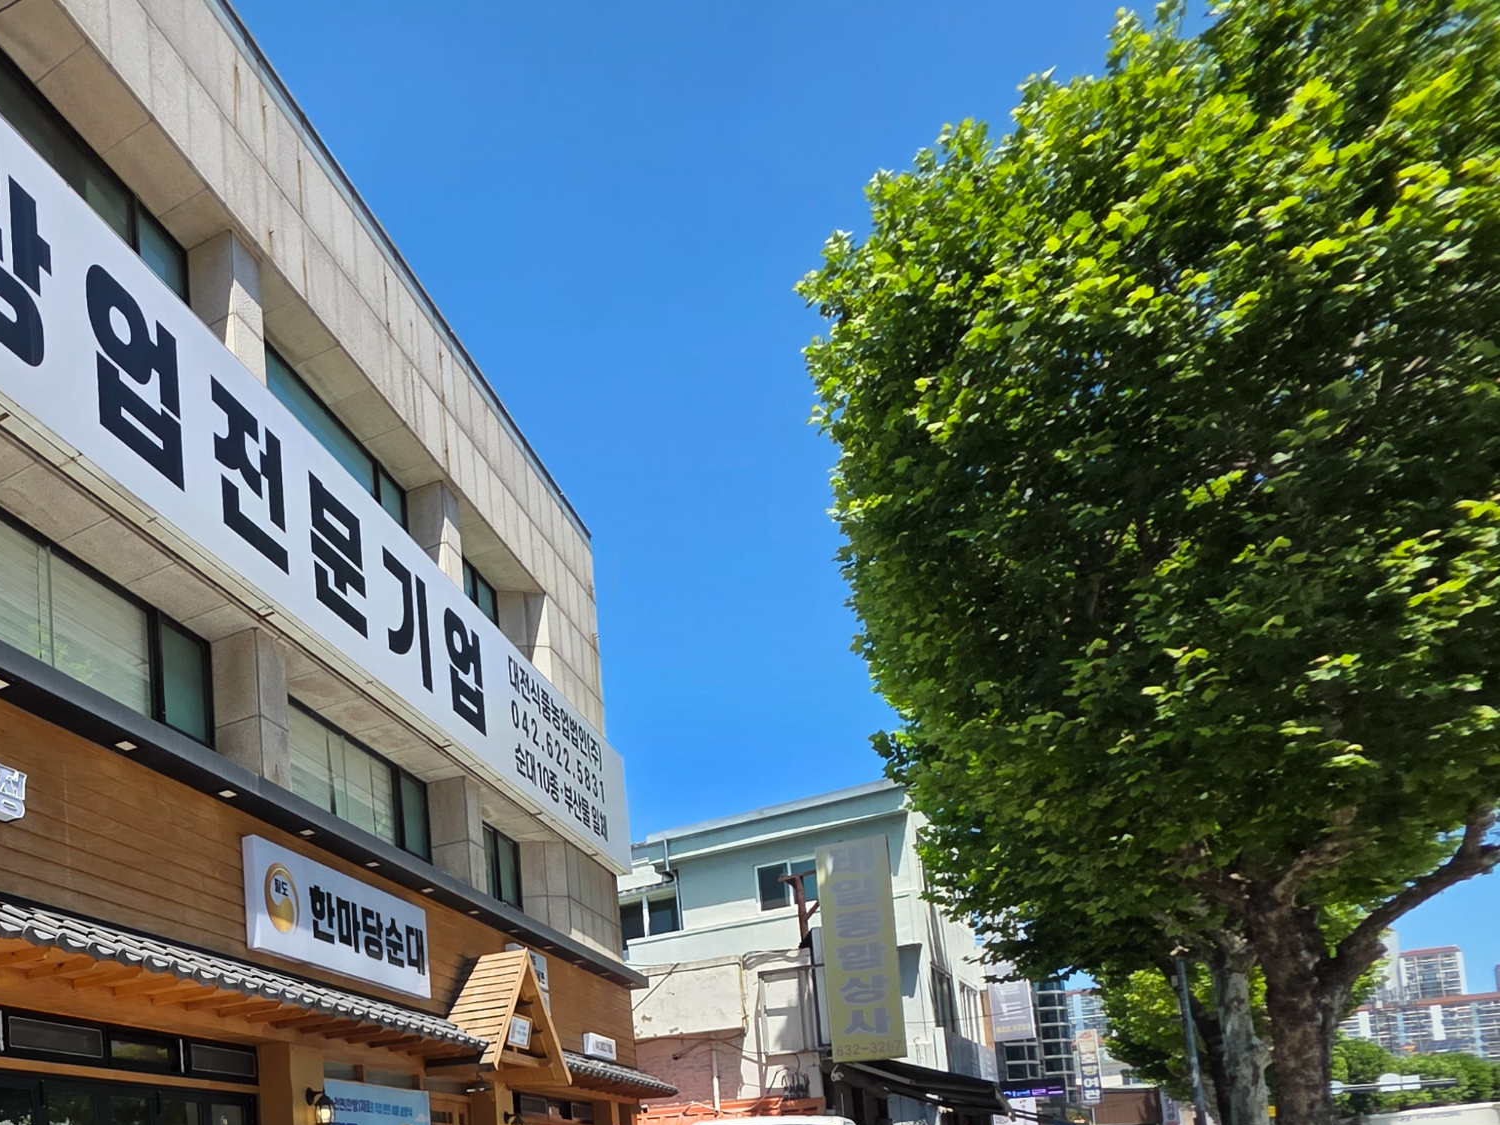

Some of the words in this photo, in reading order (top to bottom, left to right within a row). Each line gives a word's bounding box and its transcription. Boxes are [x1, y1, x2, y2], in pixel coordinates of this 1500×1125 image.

[507, 654, 603, 772] 대전식품농업법인(주)
[511, 699, 606, 804] 042.622.5831
[591, 805, 609, 843] 일체
[308, 883, 426, 976] 한마당순대
[830, 842, 892, 1036] 태일종합상사
[836, 1039, 903, 1058] 632-3267
